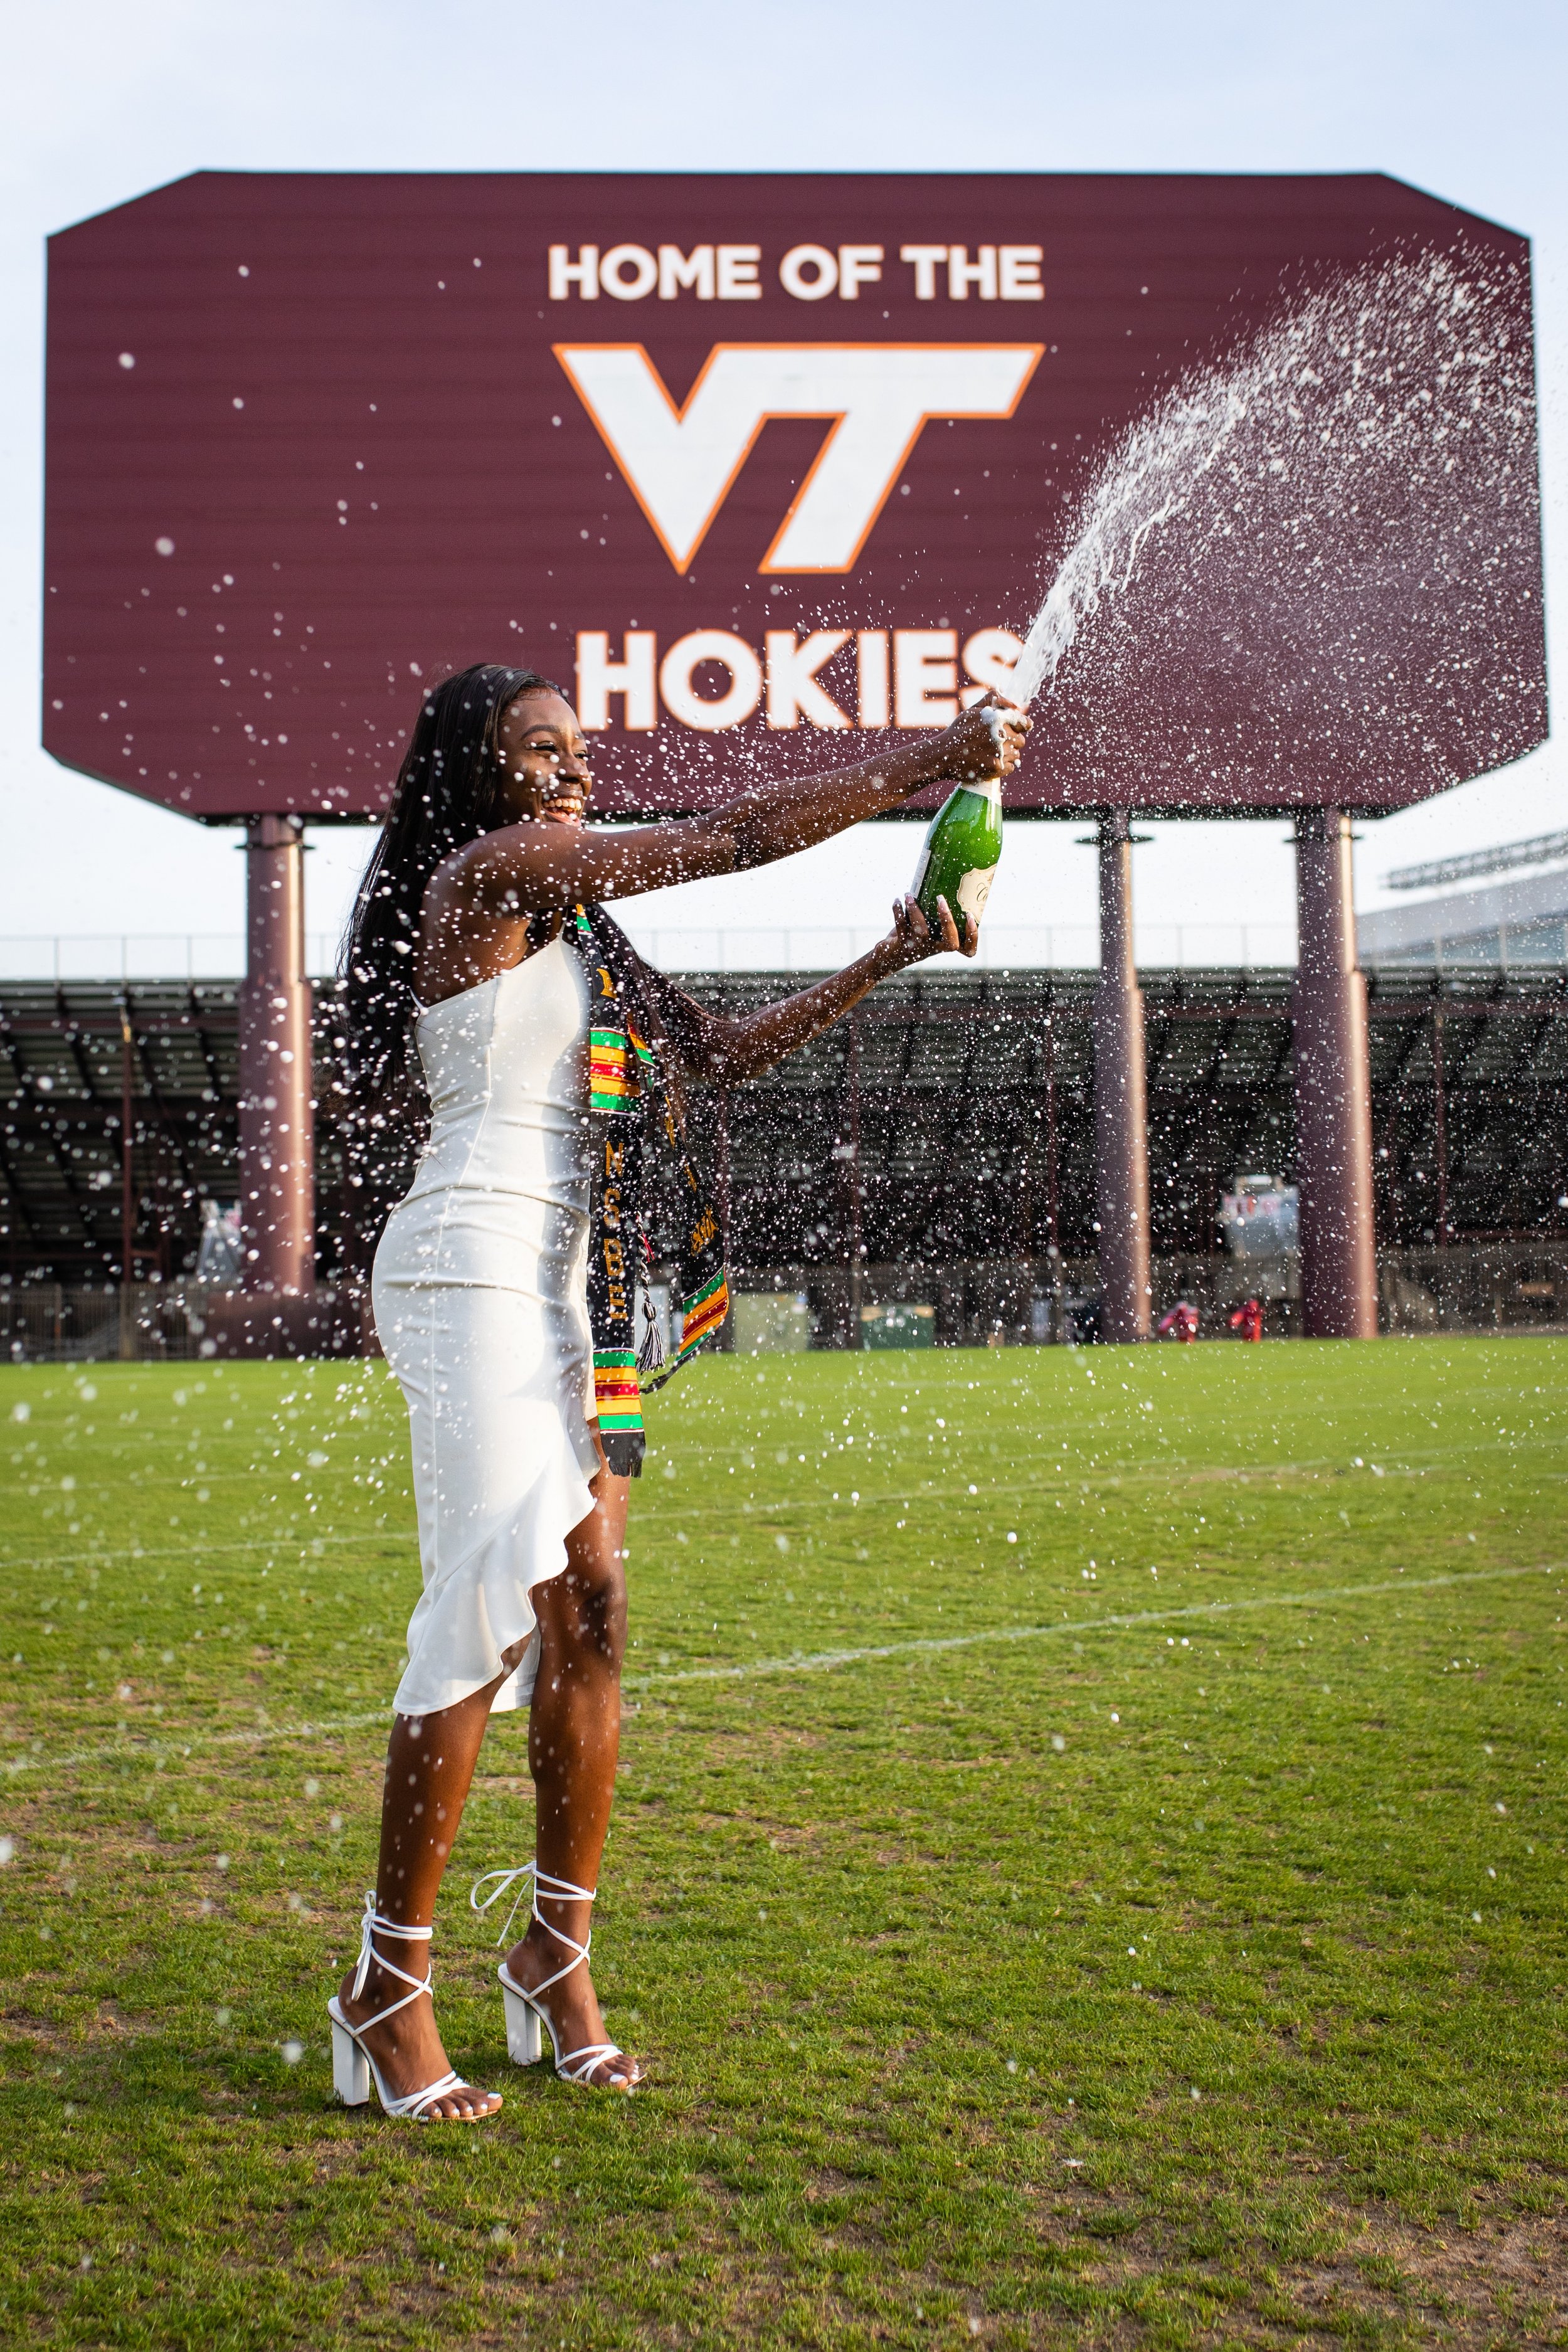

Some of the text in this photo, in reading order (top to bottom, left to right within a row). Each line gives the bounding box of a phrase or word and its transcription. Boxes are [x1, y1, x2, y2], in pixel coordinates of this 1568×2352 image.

[548, 244, 1044, 300] HOME OF THE
[551, 342, 1046, 575] VT
[576, 630, 1026, 731] HOKIES
